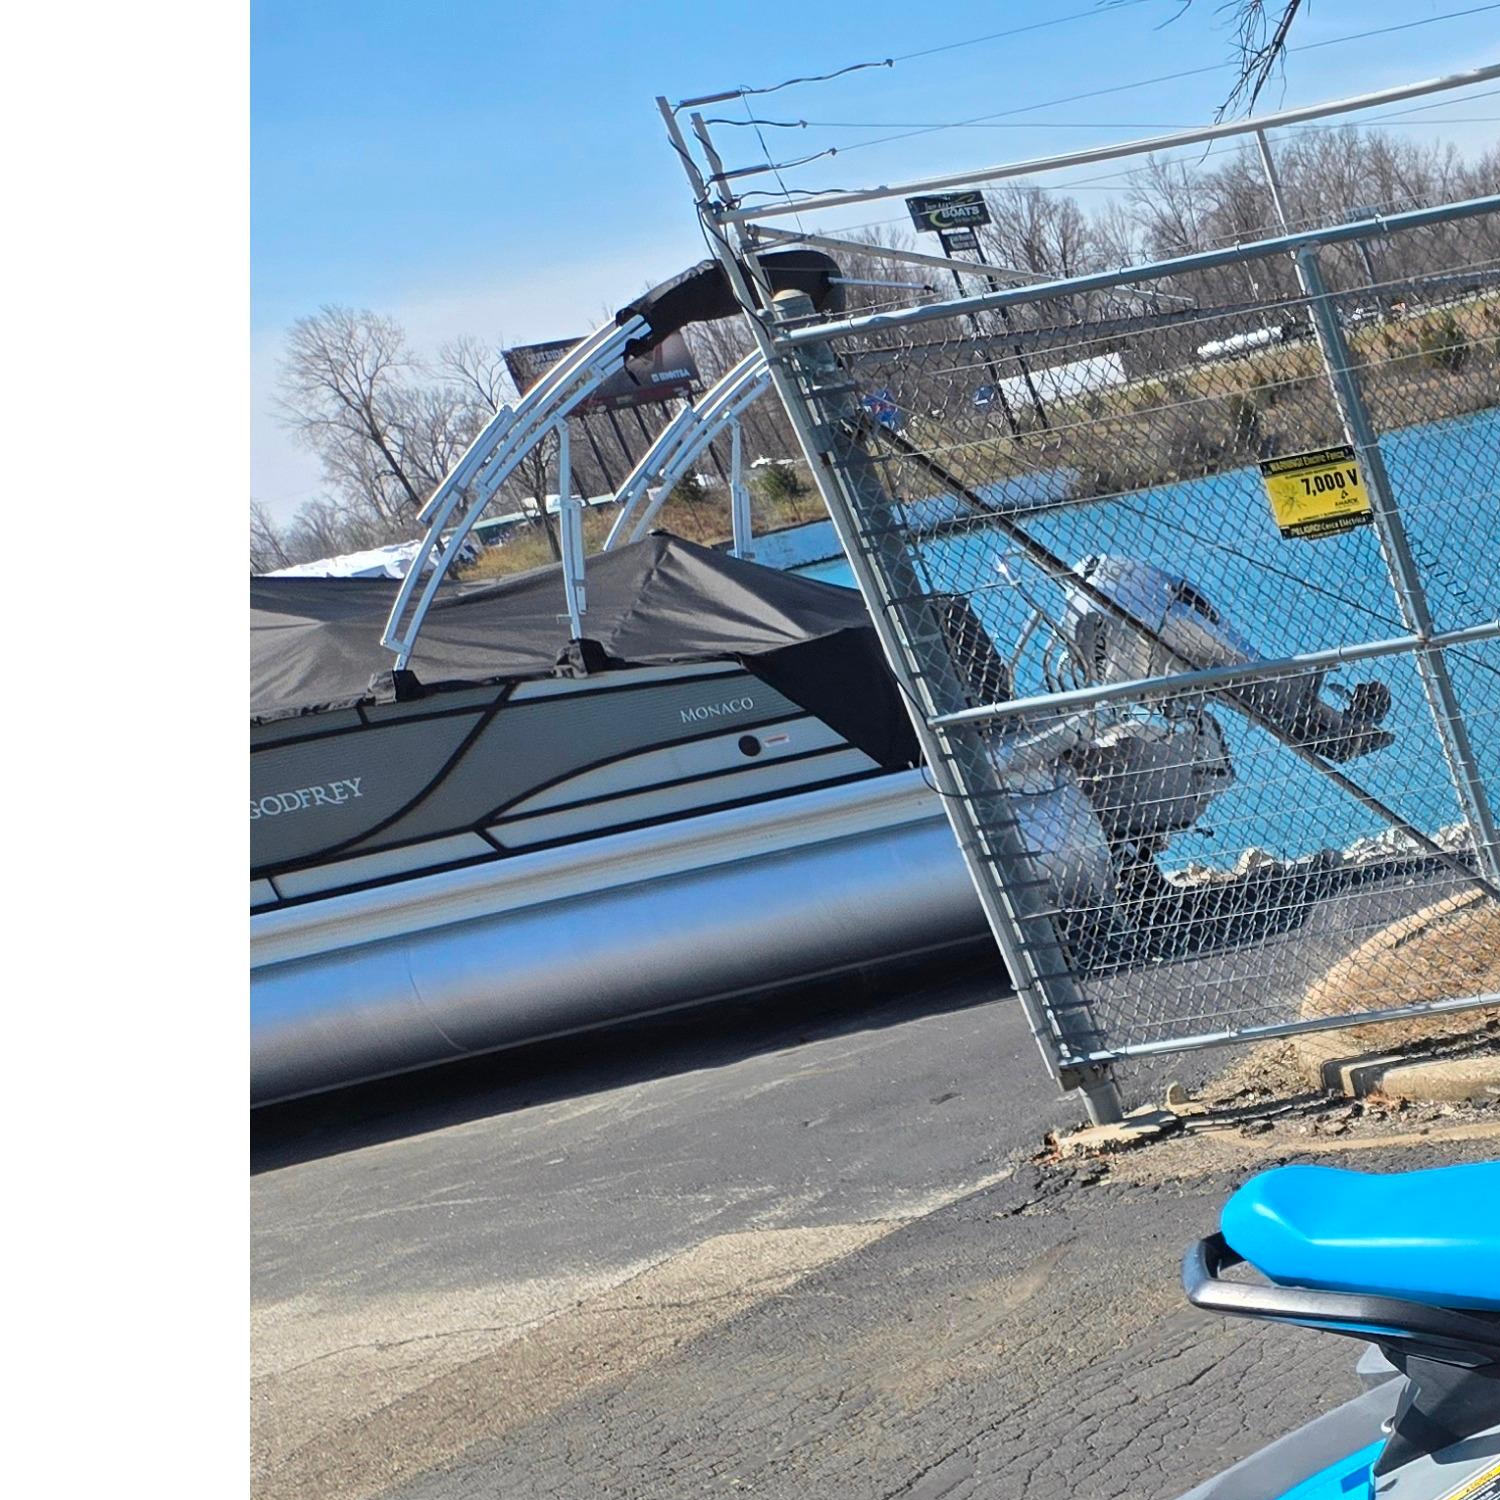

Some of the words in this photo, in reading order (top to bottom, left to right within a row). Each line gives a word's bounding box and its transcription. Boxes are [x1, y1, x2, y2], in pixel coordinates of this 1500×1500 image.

[941, 205, 980, 219] BOATS
[1301, 471, 1346, 496] 7,000
[1346, 468, 1358, 486] V
[680, 697, 754, 723] MONACO
